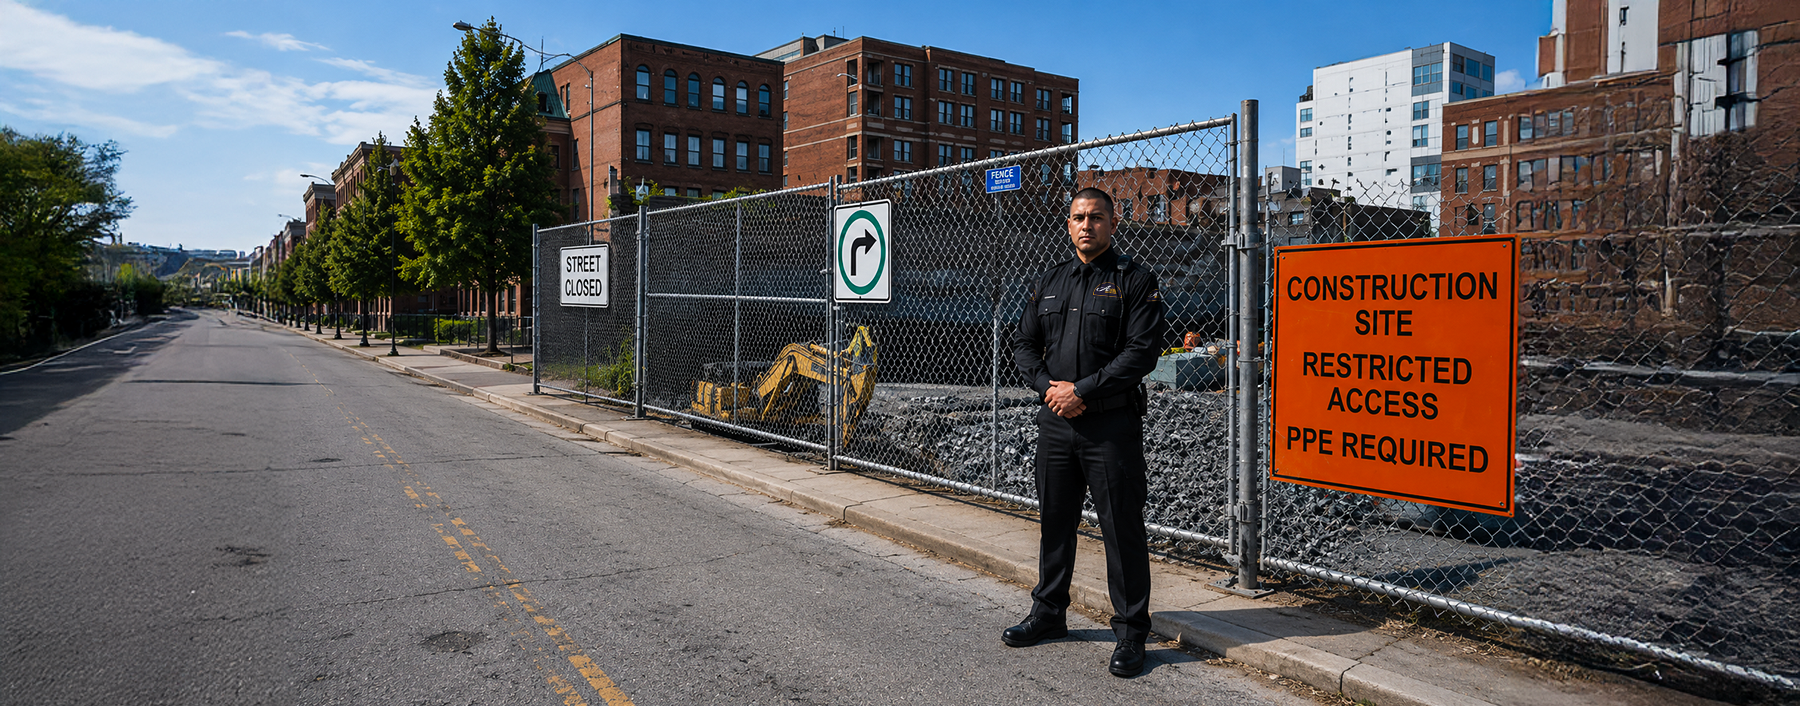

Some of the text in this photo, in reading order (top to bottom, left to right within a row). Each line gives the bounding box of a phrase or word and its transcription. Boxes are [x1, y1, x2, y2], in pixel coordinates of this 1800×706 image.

[991, 169, 1014, 179] FENCE
[566, 255, 601, 272] STREET
[565, 279, 602, 296] CLOSED
[1287, 272, 1498, 301] CONSTRUCTION
[1355, 309, 1412, 336] SITE
[1303, 352, 1472, 385] RESTRICTED
[1327, 387, 1438, 420] ACCESS
[1287, 426, 1489, 473] PPE REQUIRED
